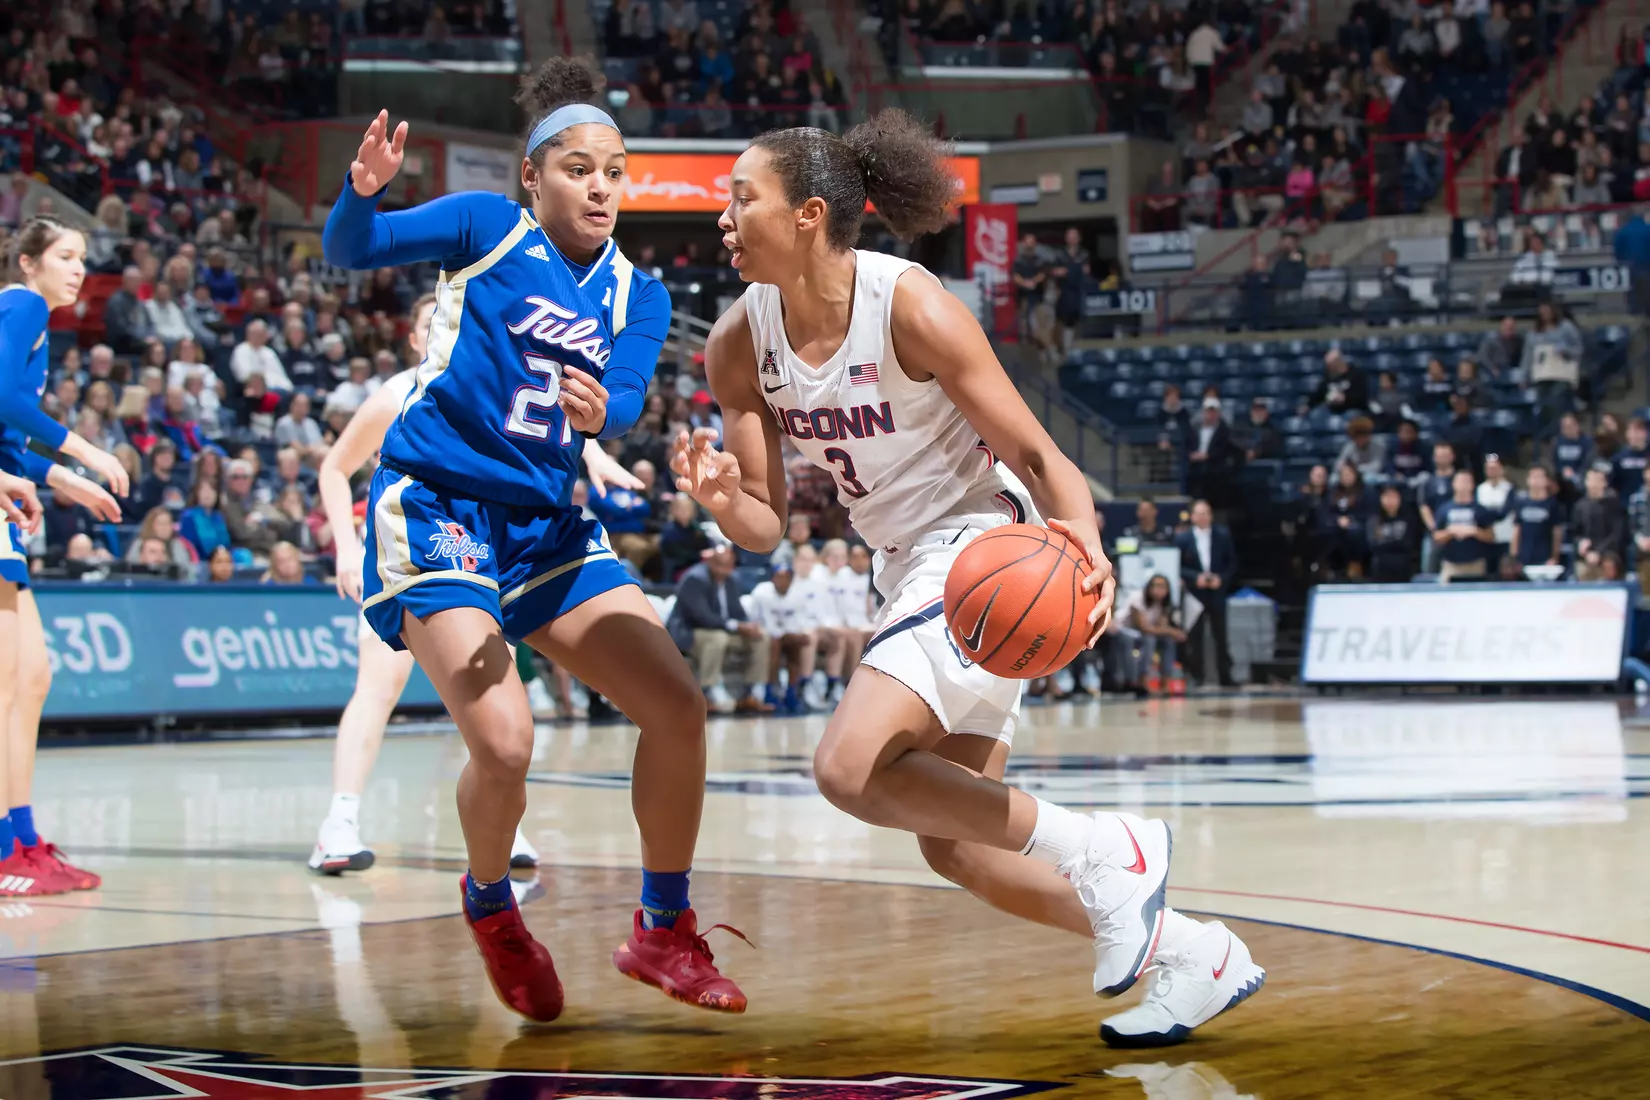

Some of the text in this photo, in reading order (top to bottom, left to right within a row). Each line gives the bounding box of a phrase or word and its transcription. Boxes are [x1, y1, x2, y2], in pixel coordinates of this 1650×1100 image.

[1588, 266, 1629, 291] 101
[1119, 289, 1155, 312] 101
[506, 295, 611, 370] Tulsa
[823, 447, 869, 498] 3
[425, 533, 489, 561] Tulsa
[173, 610, 359, 687] genius3
[1010, 634, 1047, 672] UCONN
[1312, 626, 1566, 663] TRAVELERS
